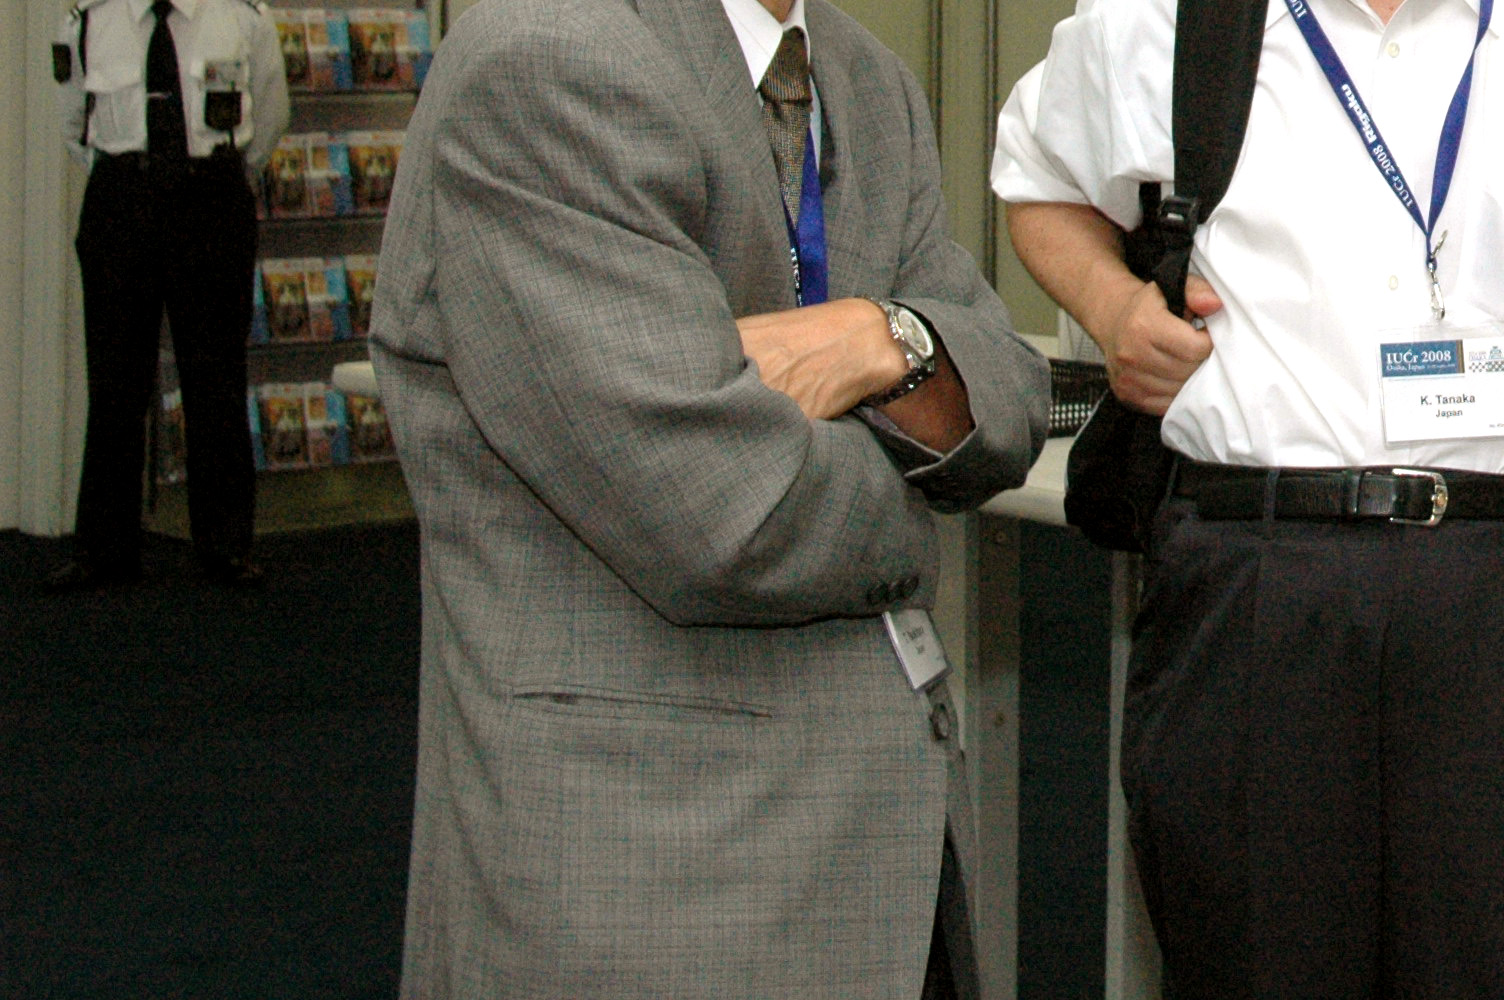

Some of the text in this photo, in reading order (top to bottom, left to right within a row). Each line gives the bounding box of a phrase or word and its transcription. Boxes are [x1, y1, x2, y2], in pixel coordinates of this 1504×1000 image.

[1341, 83, 1413, 207] IUCr 2008 Rigaku
[1421, 350, 1451, 363] 2008
[1420, 393, 1476, 406] K. Tanaka
[1435, 409, 1463, 419] Japan
